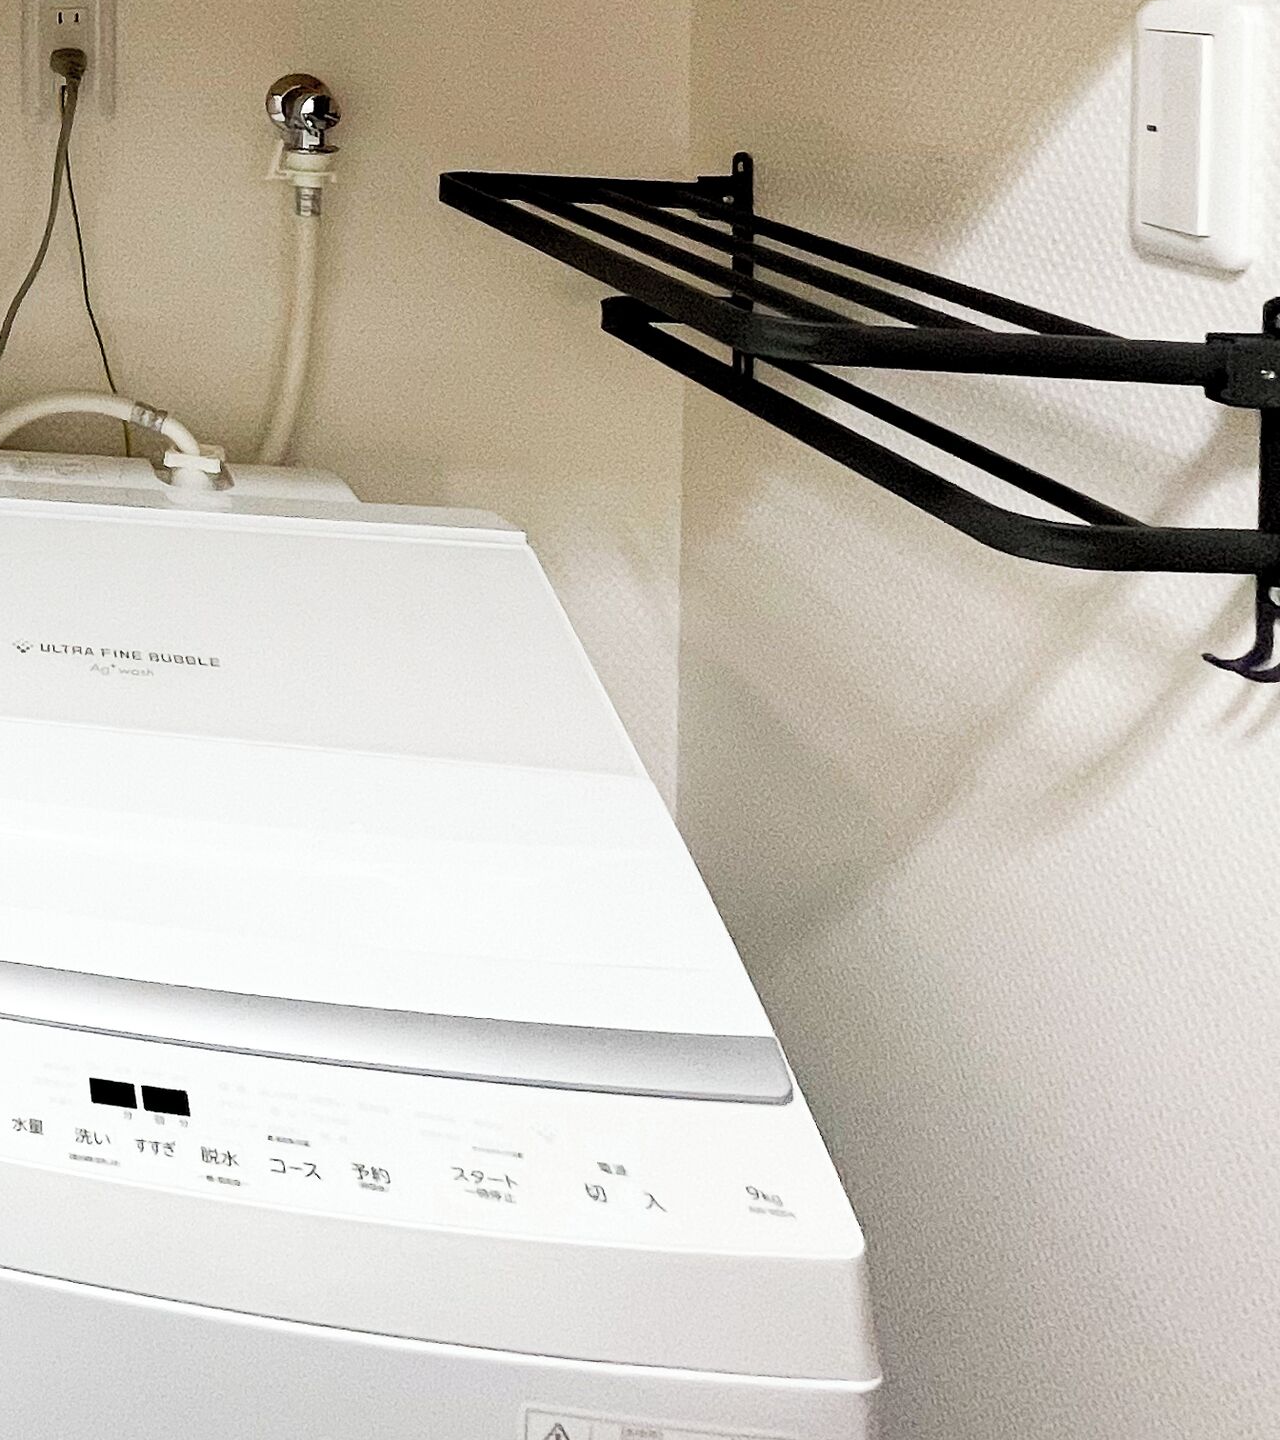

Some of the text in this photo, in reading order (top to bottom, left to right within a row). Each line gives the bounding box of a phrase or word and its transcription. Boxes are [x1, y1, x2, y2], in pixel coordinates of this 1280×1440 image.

[40, 642, 221, 668] ULTRA FINE BUBBLE
[11, 1116, 45, 1136] 水量
[74, 1127, 111, 1146] 洗い
[134, 1137, 177, 1158] すすぎ
[200, 1146, 240, 1168] 脱水
[268, 1157, 322, 1181] コース
[449, 1165, 519, 1188] スタート
[584, 1183, 607, 1204] 切
[644, 1191, 668, 1213] 入
